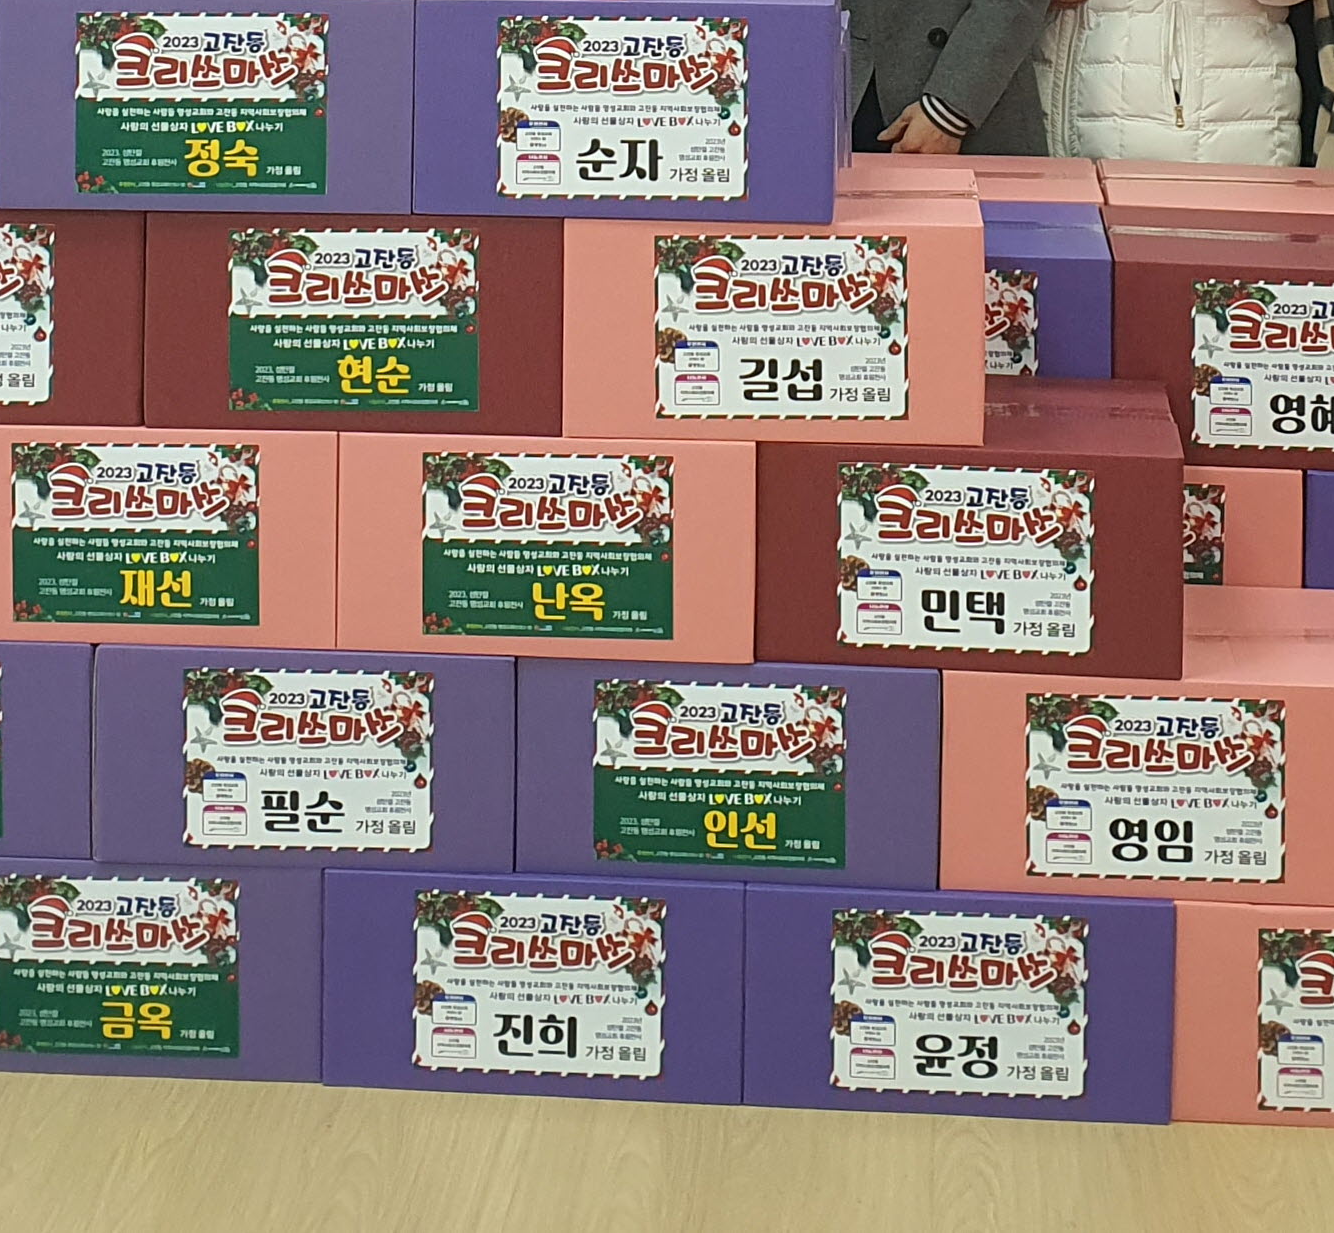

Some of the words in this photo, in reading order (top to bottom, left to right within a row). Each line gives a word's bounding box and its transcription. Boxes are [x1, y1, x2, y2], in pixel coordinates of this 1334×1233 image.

[162, 36, 199, 47] 2023
[203, 31, 266, 51] 고잔동
[582, 41, 619, 52] 2023
[623, 36, 686, 56] 고잔동
[186, 139, 258, 176] 정숙
[576, 138, 663, 181] 순자
[670, 167, 698, 182] 가정
[702, 167, 730, 182] 올림
[314, 252, 350, 263] 2023
[354, 247, 416, 268] 고잔동
[338, 355, 410, 393] 현순
[739, 358, 822, 401] 길섭
[830, 387, 858, 402] 가정
[862, 387, 891, 402] 올림
[924, 490, 962, 502] 2023
[966, 486, 1030, 509] 고잔동
[121, 570, 191, 607] 재선
[532, 583, 605, 620] 난옥
[921, 589, 1004, 634] 민택
[680, 705, 716, 717] 2023
[721, 701, 783, 724] 고잔동
[261, 790, 344, 832] 필순
[356, 819, 384, 834] 가정
[388, 820, 416, 835] 올림
[704, 811, 776, 849] 인선
[1109, 818, 1192, 862] 영임
[76, 899, 112, 911] 2023
[116, 895, 177, 916] 고잔동
[499, 916, 536, 929] 2023
[540, 913, 603, 935] 고잔동
[918, 936, 956, 948] 2023
[960, 932, 1024, 954] 고잔동
[102, 1002, 172, 1039] 금옥
[493, 1014, 577, 1058] 진희
[913, 1034, 997, 1078] 윤정
[1007, 1065, 1036, 1080] 가정
[1040, 1066, 1069, 1081] 올림
